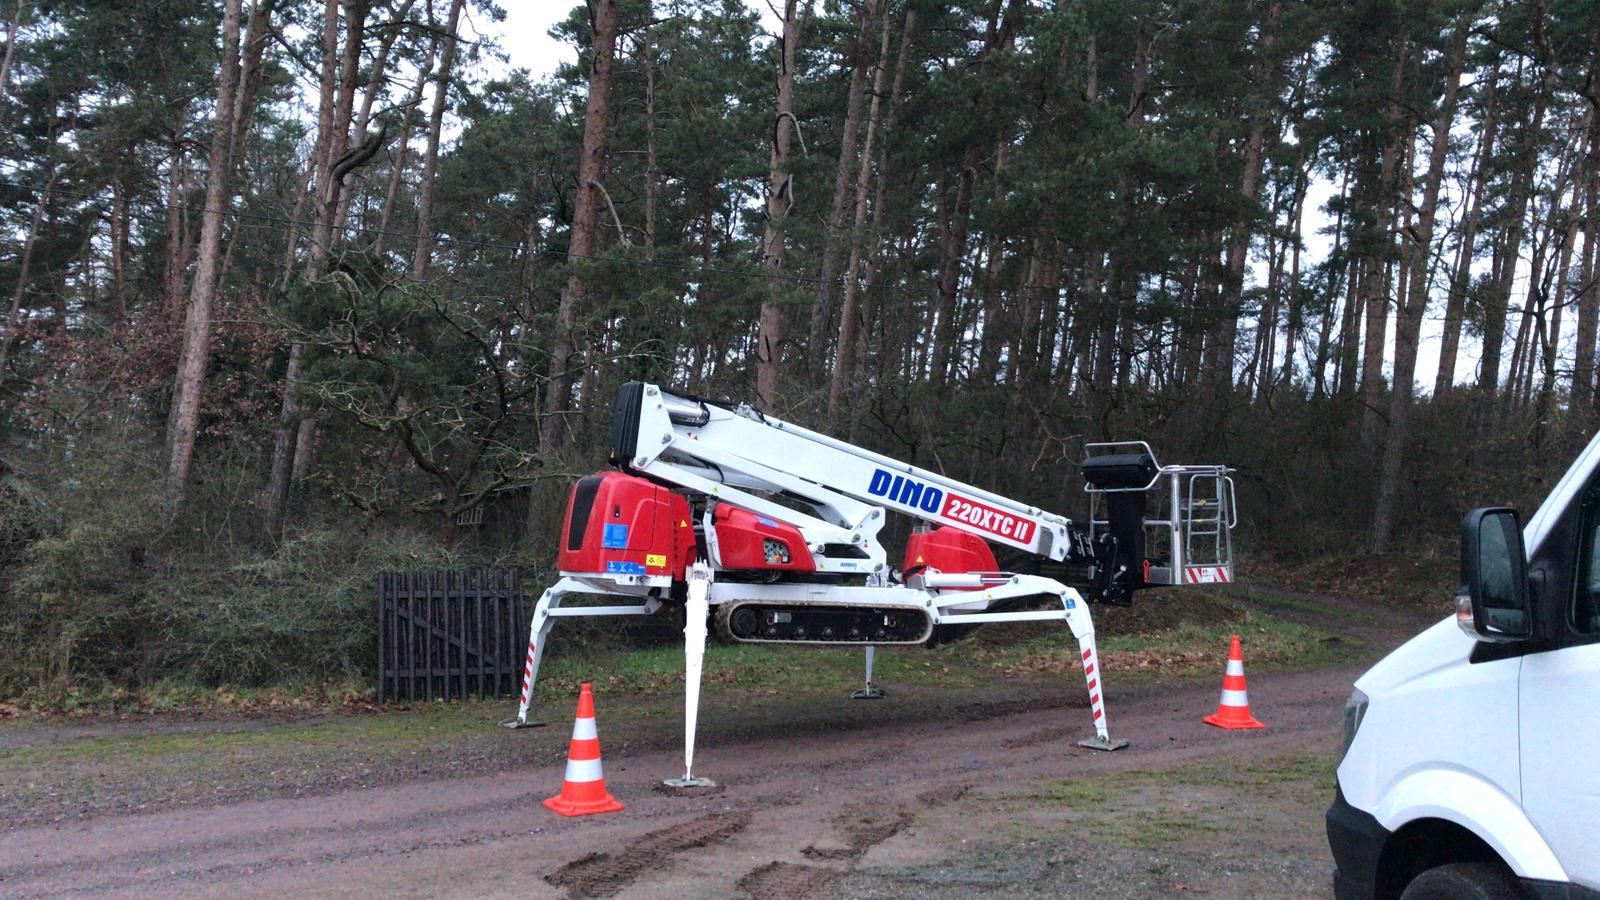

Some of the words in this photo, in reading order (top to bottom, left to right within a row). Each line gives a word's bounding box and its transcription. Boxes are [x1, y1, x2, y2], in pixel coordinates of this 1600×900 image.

[868, 469, 943, 513] DINO
[947, 500, 1012, 534] 220XTC
[1014, 522, 1028, 540] II
